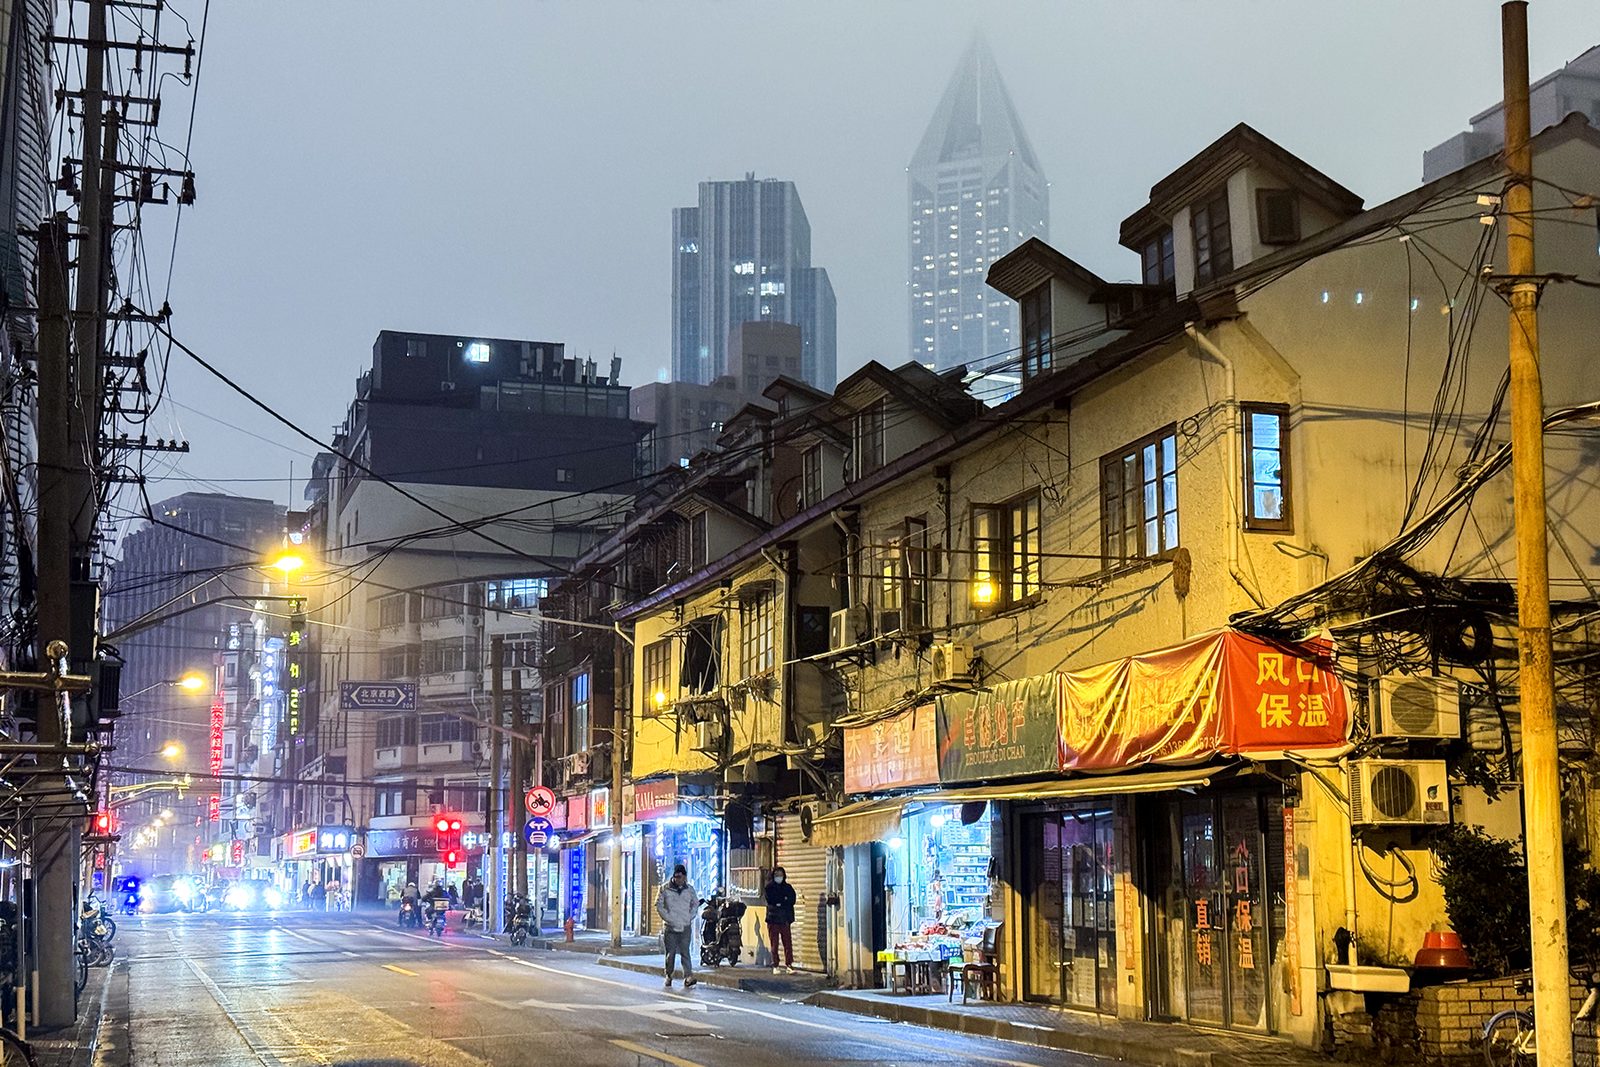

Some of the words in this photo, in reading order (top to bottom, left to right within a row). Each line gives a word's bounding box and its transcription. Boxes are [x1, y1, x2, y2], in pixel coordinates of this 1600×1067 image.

[1255, 652, 1320, 687] 风口
[360, 689, 396, 698] 北京西路
[1255, 692, 1330, 729] 保温
[635, 790, 655, 812] KAMA
[1195, 897, 1212, 965] 直销
